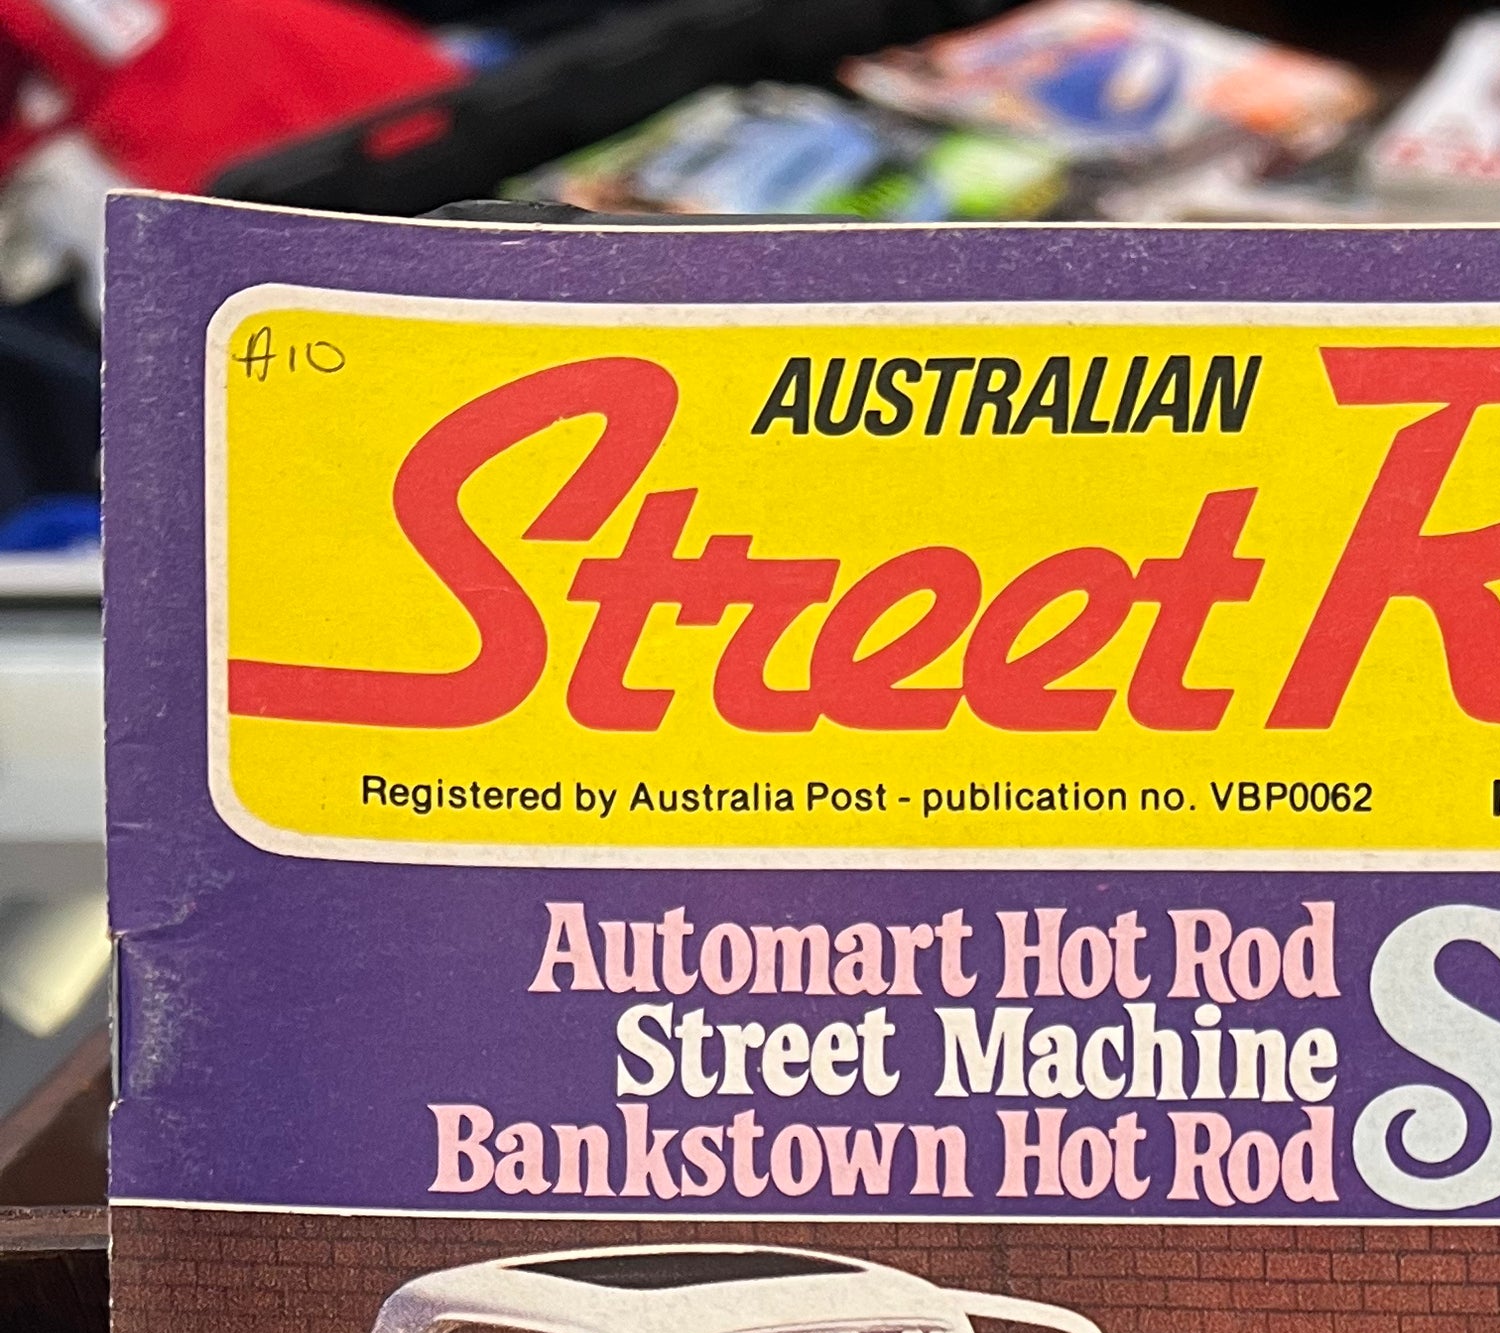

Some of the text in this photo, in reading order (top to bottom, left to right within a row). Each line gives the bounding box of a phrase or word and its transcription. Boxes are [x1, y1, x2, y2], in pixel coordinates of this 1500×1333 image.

[230, 325, 346, 382] A10
[752, 355, 1261, 436] AUSTRALIAN
[228, 357, 1265, 732] Street
[362, 775, 561, 814] Registered
[575, 782, 616, 818] by
[629, 782, 794, 812] Australia
[806, 782, 886, 812] Post
[923, 782, 1127, 818] publication
[1140, 787, 1196, 812] no.
[1211, 781, 1372, 813] VBP0062
[528, 901, 1340, 1002] Automart Hot Rod
[616, 1002, 1338, 1102] Street Machine
[427, 1103, 1340, 1206] Bankstown Hot Rod
